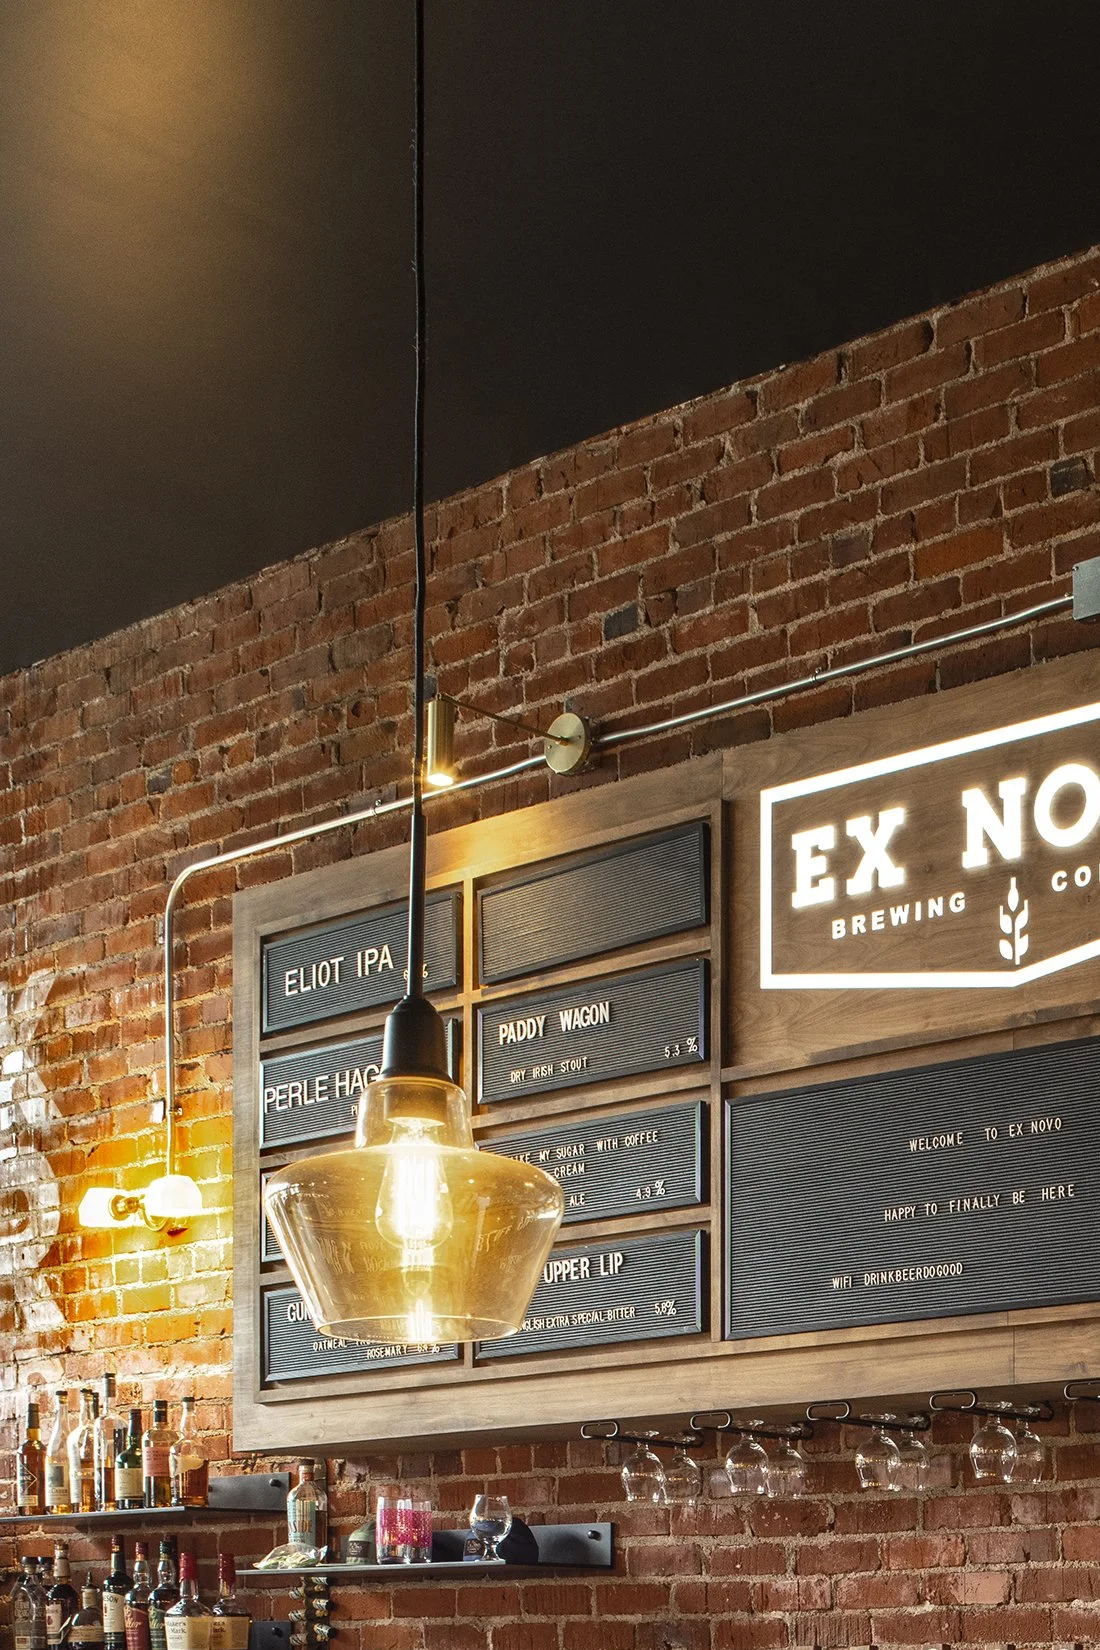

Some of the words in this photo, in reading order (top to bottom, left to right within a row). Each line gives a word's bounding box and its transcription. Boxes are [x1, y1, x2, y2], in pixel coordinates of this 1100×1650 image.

[790, 806, 906, 909] EX
[831, 891, 968, 941] BREWING
[284, 956, 345, 997] ELIOT
[356, 942, 394, 979] IPA
[498, 1014, 547, 1046] PADDY
[558, 1001, 610, 1033] WAGON
[510, 1066, 528, 1084] DRY
[532, 1061, 554, 1081] IRISH
[560, 1056, 588, 1074] STOUT
[263, 1075, 330, 1115] PERLE
[539, 1149, 551, 1163] MY
[556, 1143, 586, 1160] SUGAR
[596, 1137, 619, 1152] WITH
[624, 1130, 659, 1148] COFFEE
[908, 1131, 964, 1153] WELCOME
[984, 1125, 999, 1142] TO
[1008, 1122, 1024, 1139] EX
[1030, 1116, 1064, 1136] NOVO
[554, 1162, 586, 1179] CREAM
[569, 1193, 586, 1207] ALE
[883, 1205, 917, 1224] HAPPY
[924, 1200, 939, 1218] TO
[948, 1193, 1002, 1215] FINALLY
[1012, 1189, 1026, 1206] BE
[1041, 1182, 1076, 1202] HERE
[542, 1258, 591, 1284] UPPER
[598, 1252, 624, 1277] LIP
[831, 1274, 853, 1292] WIFI
[863, 1261, 964, 1288] DRINKBEERDOGOOD
[545, 1315, 571, 1330] EXTRA
[571, 1310, 605, 1326] SPECIAL
[607, 1306, 636, 1322] BITTER
[312, 1338, 348, 1352] OATMEAL
[366, 1344, 408, 1360] ROSEMARY
